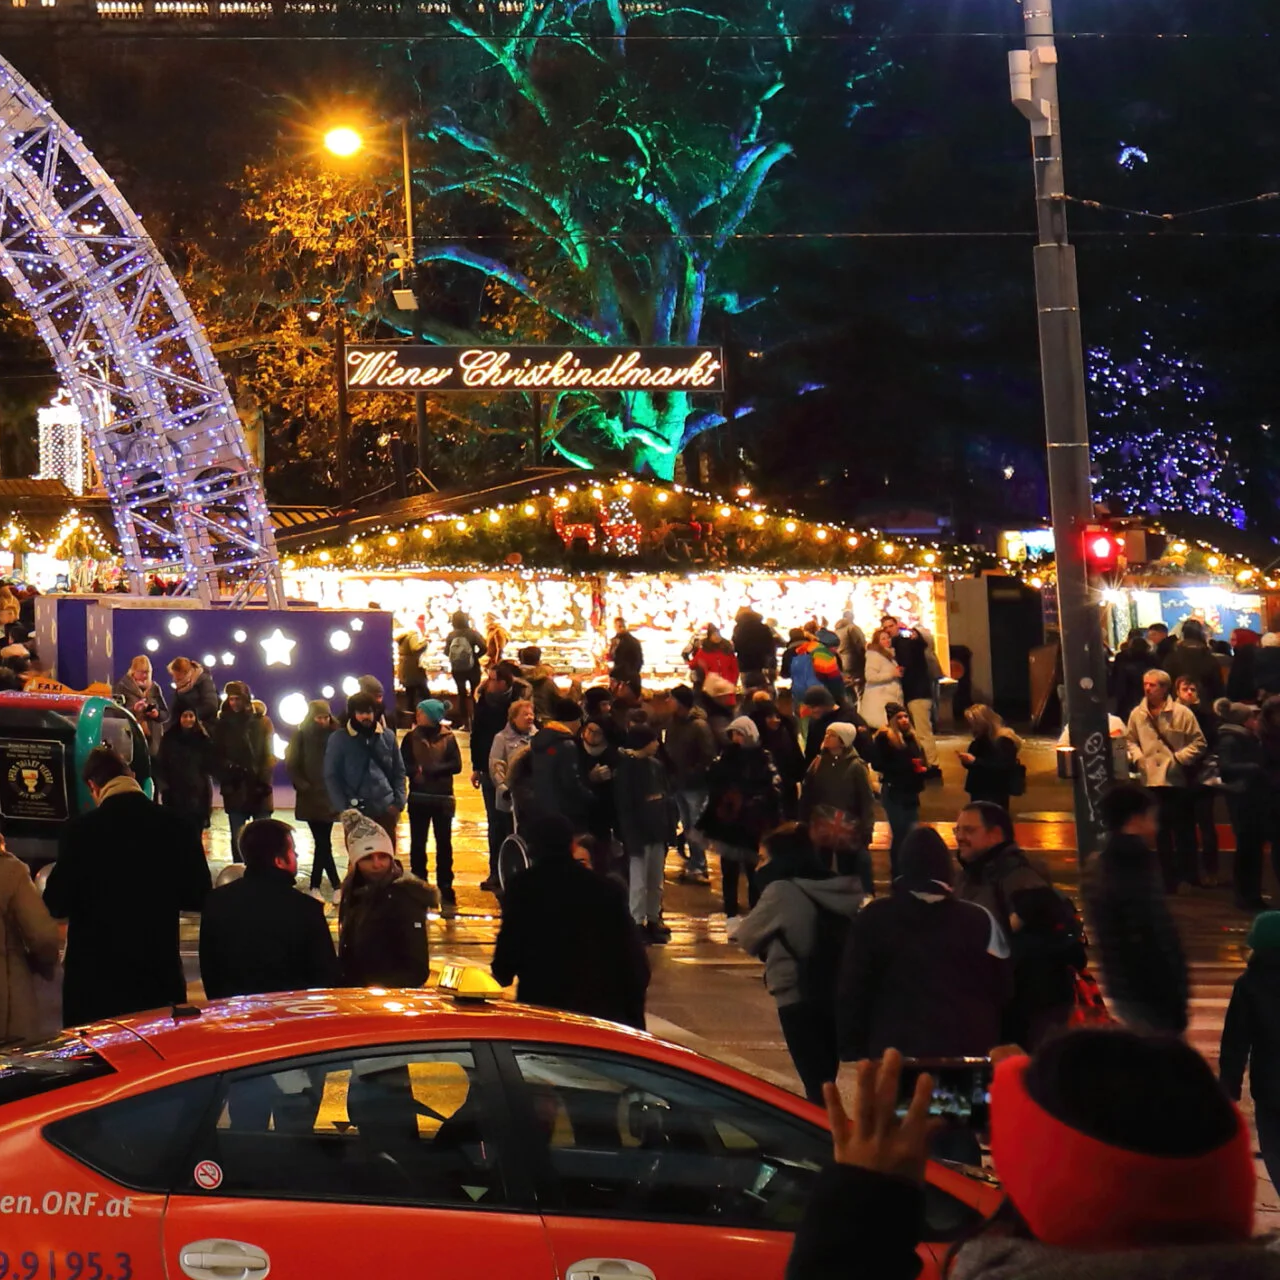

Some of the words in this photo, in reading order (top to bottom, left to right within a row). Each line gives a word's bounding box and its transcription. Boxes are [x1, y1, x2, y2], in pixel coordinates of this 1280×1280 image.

[346, 350, 453, 387] Wiener
[459, 349, 722, 387] Christkindlmarkt
[65, 1251, 133, 1280] 95.3
